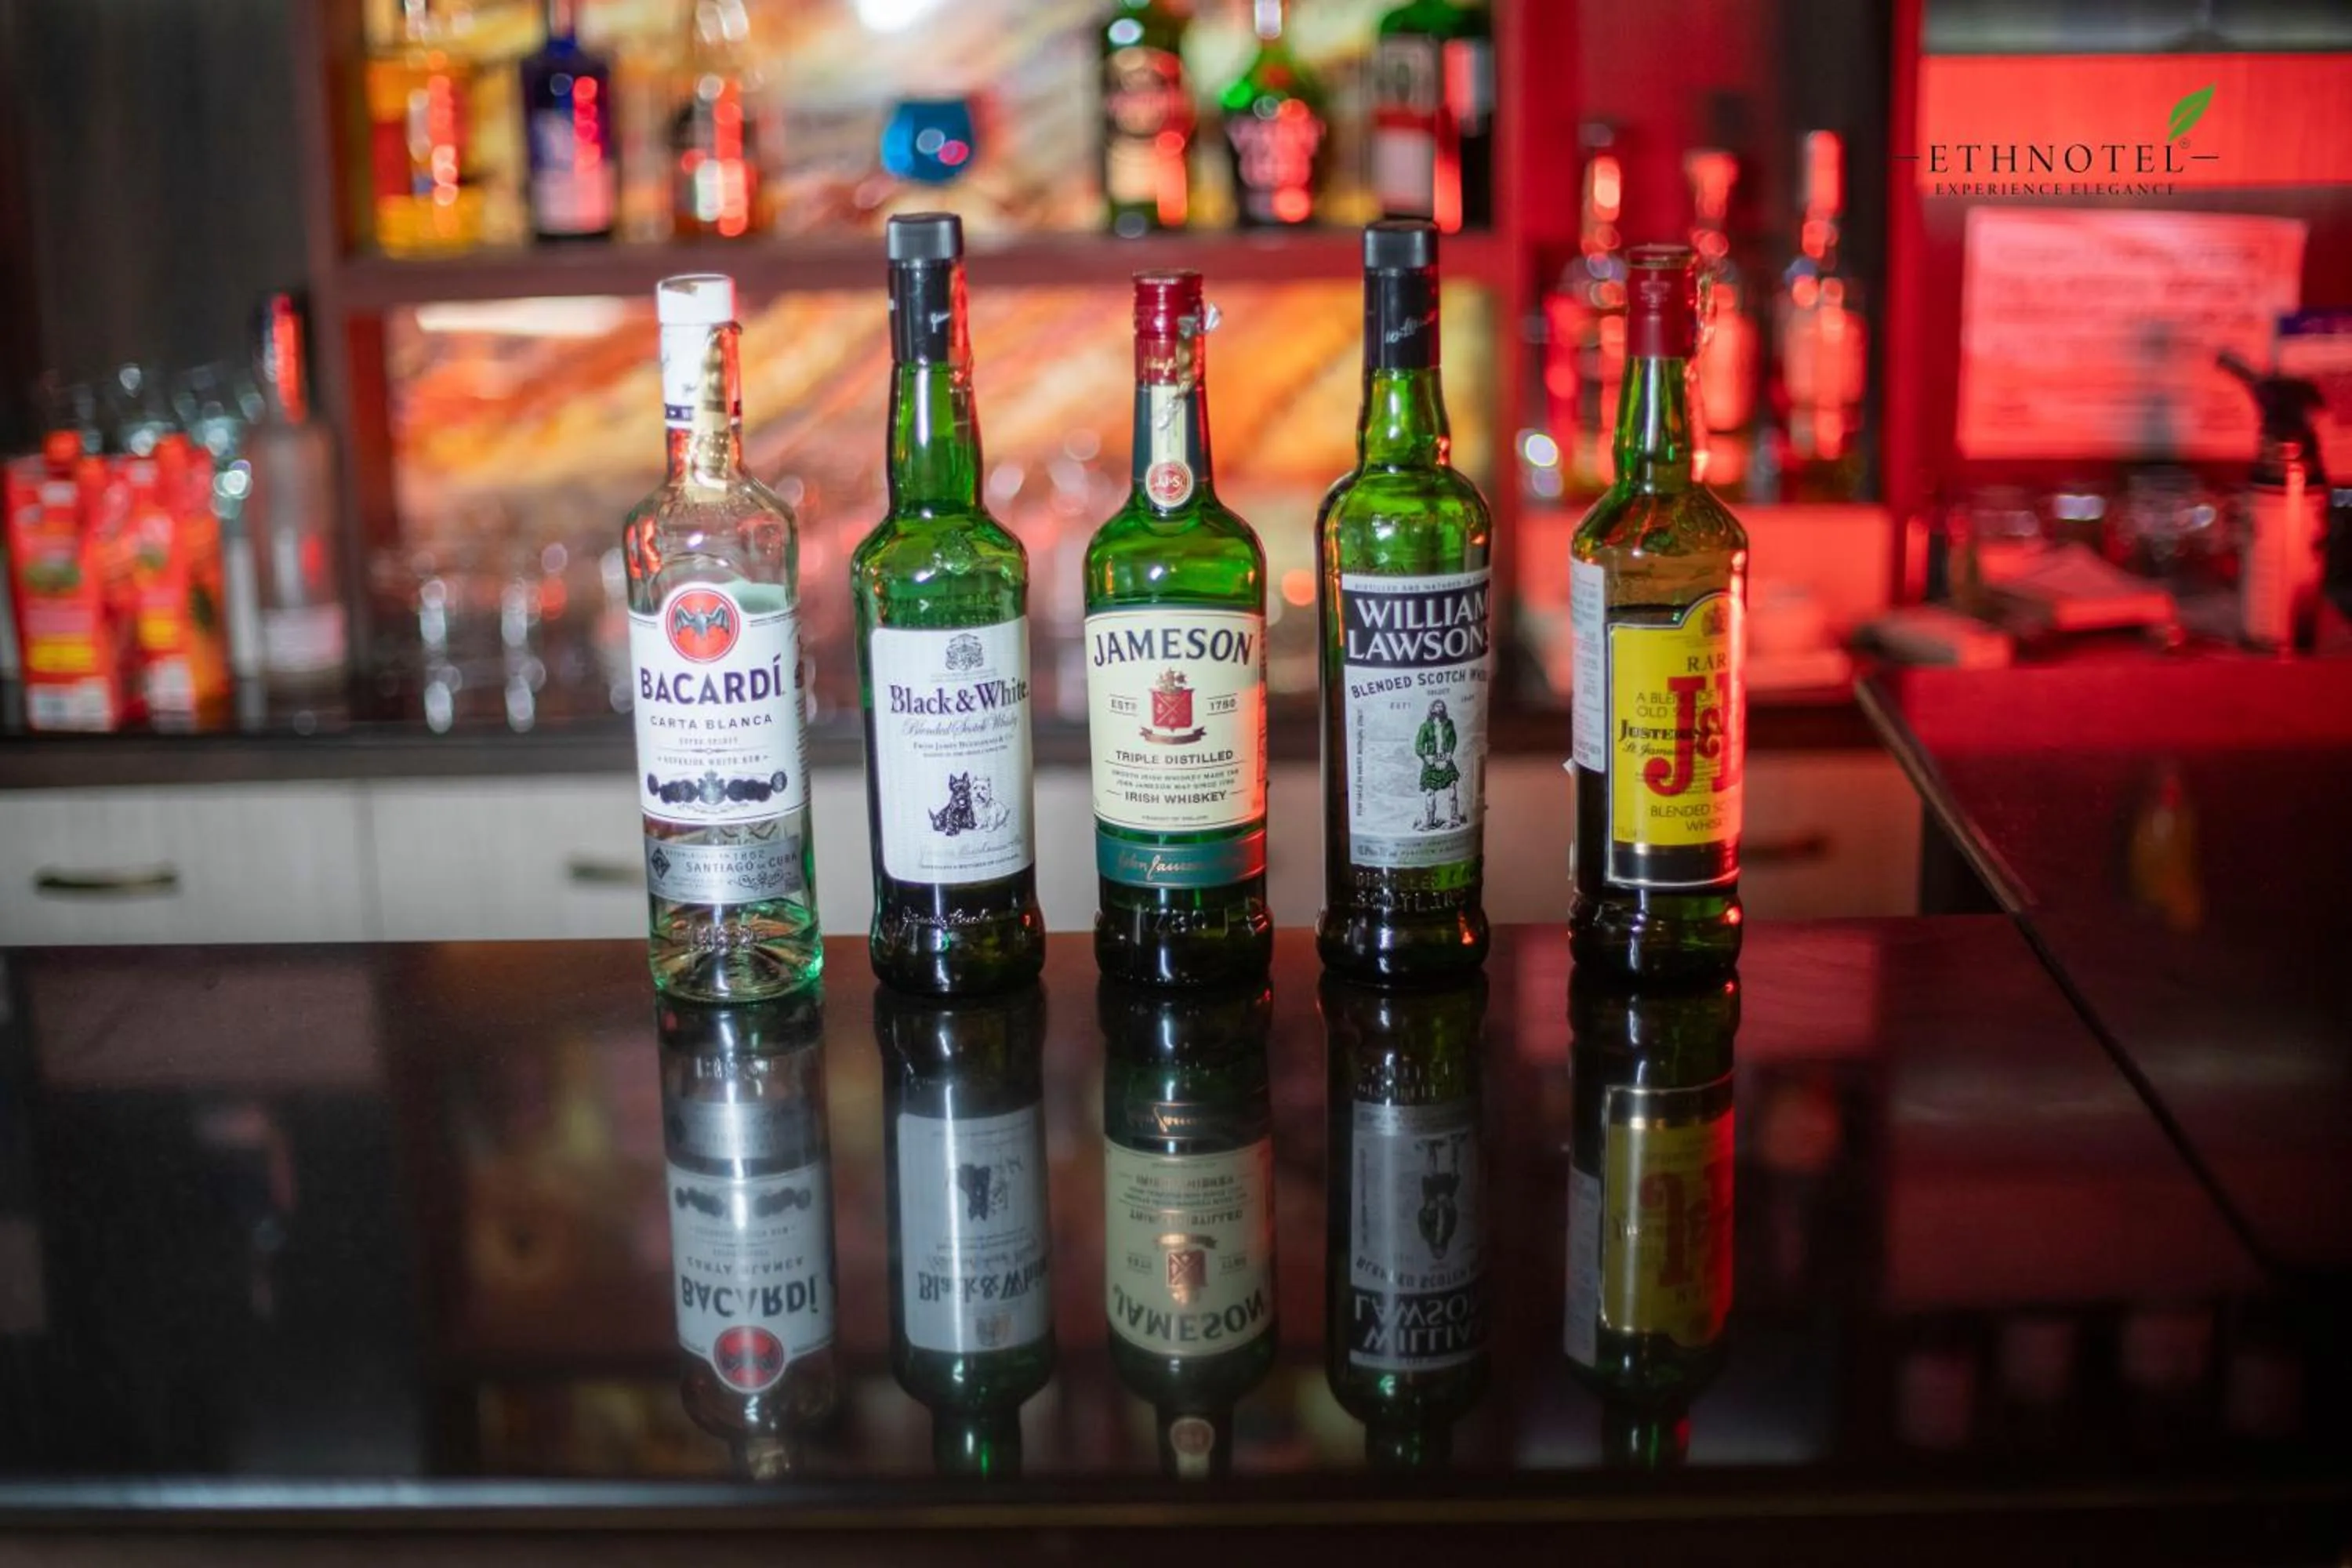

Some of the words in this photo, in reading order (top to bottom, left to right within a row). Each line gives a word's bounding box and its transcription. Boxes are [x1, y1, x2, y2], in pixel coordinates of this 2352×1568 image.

[1355, 590, 1488, 630] WILLIAM
[1094, 628, 1254, 666] JAMESON
[1686, 652, 1727, 672] RAR
[640, 652, 782, 705] BACARDÍ
[1351, 676, 1412, 699] BLENDED
[1417, 670, 1466, 687] SCOTCH
[1636, 706, 1668, 718] OLD
[650, 715, 698, 730] CARTA
[706, 713, 773, 730] BLANCA
[1116, 750, 1160, 764] TRIPLE
[1164, 750, 1234, 764] DISTILLED
[1125, 790, 1160, 804] IRISH
[1164, 789, 1227, 804] WHISKEY
[1650, 804, 1710, 817] BLENDED
